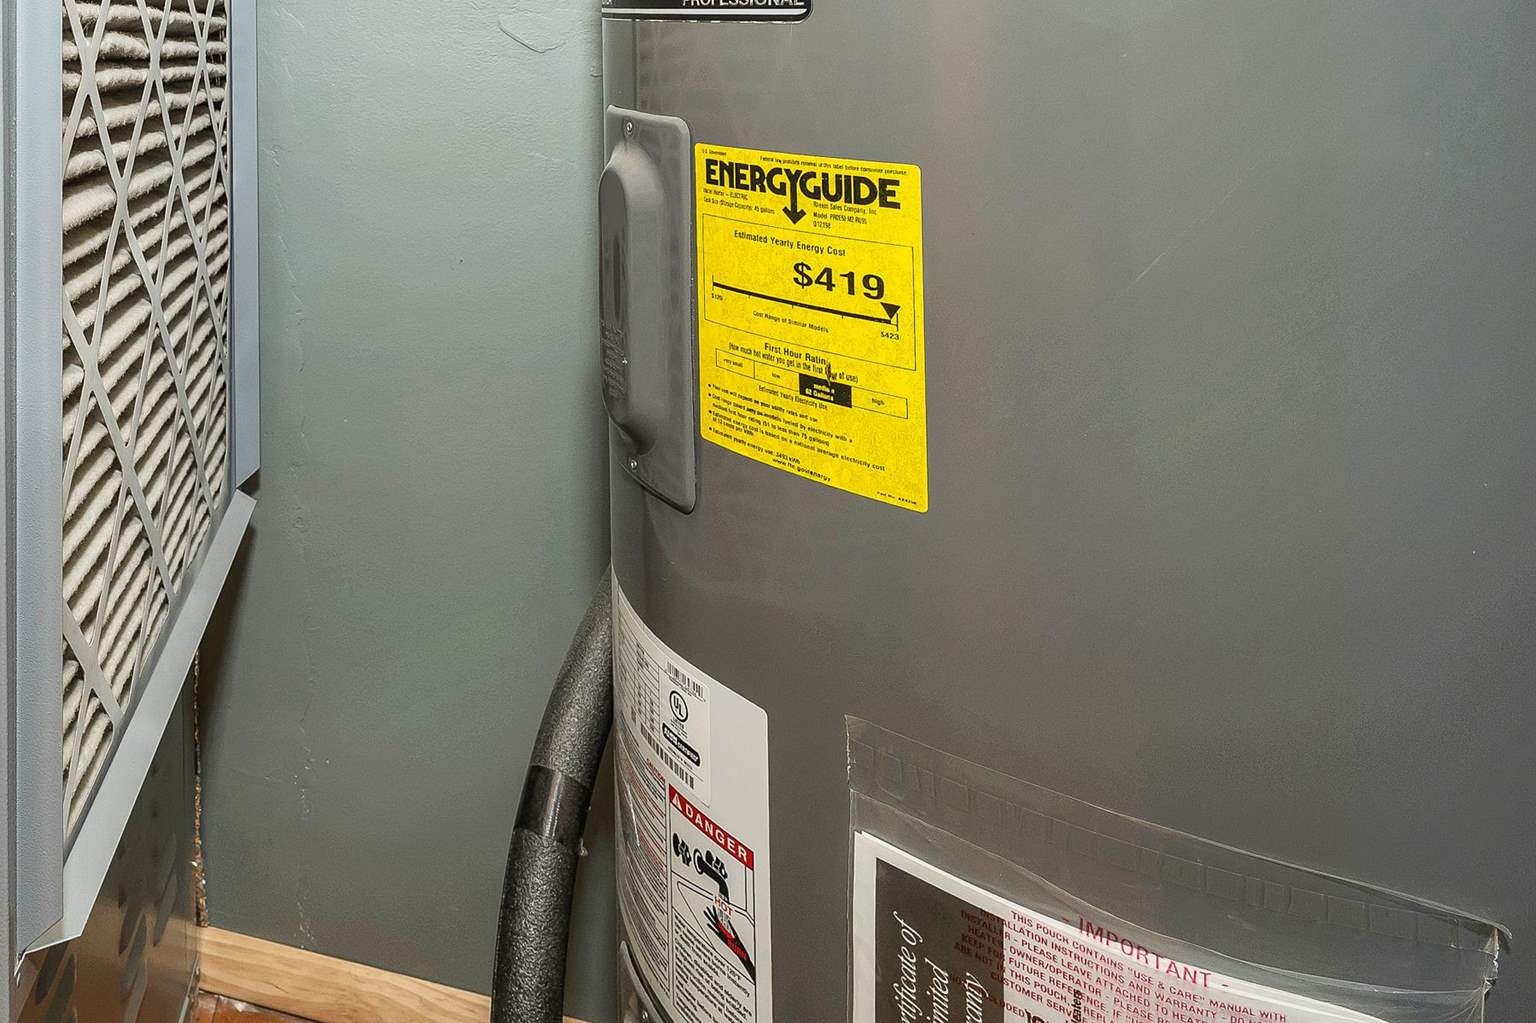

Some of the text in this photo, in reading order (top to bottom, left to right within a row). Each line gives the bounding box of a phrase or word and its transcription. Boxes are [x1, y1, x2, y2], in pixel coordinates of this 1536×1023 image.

[705, 158, 901, 210] ENERGYGUIDE
[734, 230, 846, 256] Estimated Yearly Energy Cost
[792, 262, 885, 300] $419
[764, 343, 781, 354] First
[784, 348, 802, 359] Hour
[685, 803, 748, 863] DANGER
[714, 896, 734, 916] HOT
[893, 911, 924, 946] of
[1008, 957, 1049, 984] FUTURE
[1011, 910, 1033, 927] THIS
[1036, 924, 1070, 944] POUCH
[1072, 941, 1123, 971] CONTAINS
[1209, 1000, 1255, 1016] MANUAL
[1259, 1010, 1286, 1023] WITH
[1079, 917, 1212, 988] IMPORTANT
[991, 971, 1043, 1003] CUSTOMER
[1009, 946, 1102, 997] OWNER/OPERATOR
[1114, 997, 1154, 1022] PLEASE
[1010, 969, 1031, 986] THIS
[1021, 939, 1058, 963] PLEASE
[1061, 959, 1093, 979] LEAVE
[1095, 976, 1150, 1008] ATTACHED
[1155, 1004, 1169, 1016] TO
[1051, 941, 1124, 984] INSTRUCTIONS
[1128, 980, 1150, 996] AND
[1154, 991, 1217, 1019] WARRANTY
